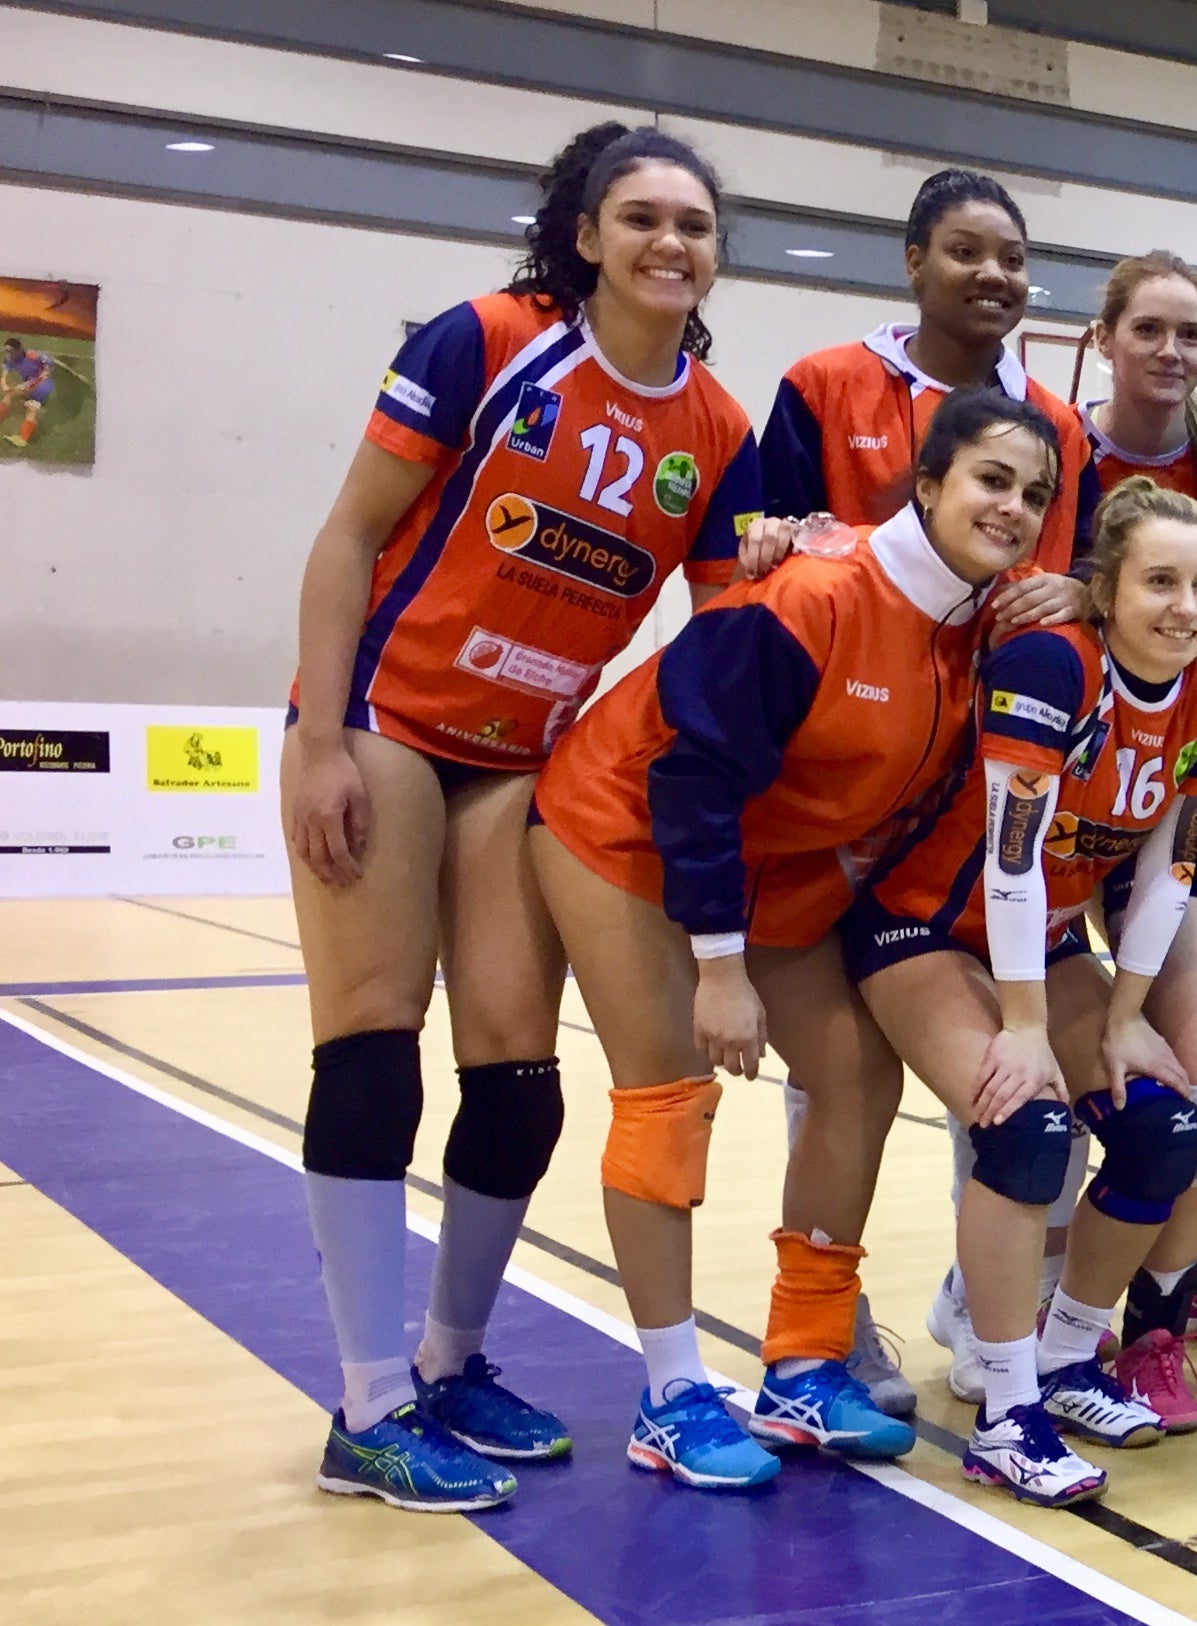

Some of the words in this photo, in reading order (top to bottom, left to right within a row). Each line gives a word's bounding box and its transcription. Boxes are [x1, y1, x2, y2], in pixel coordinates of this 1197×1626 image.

[510, 437, 545, 458] Urban
[848, 435, 888, 450] VIZIUS
[580, 423, 644, 518] 12
[496, 562, 515, 583] LA
[518, 571, 559, 598] SUELA
[845, 678, 889, 702] VIZIUS
[1111, 747, 1166, 820] 16
[172, 835, 237, 849] GPE
[1002, 800, 1039, 865] dynergy
[873, 926, 931, 947] VIZIUS
